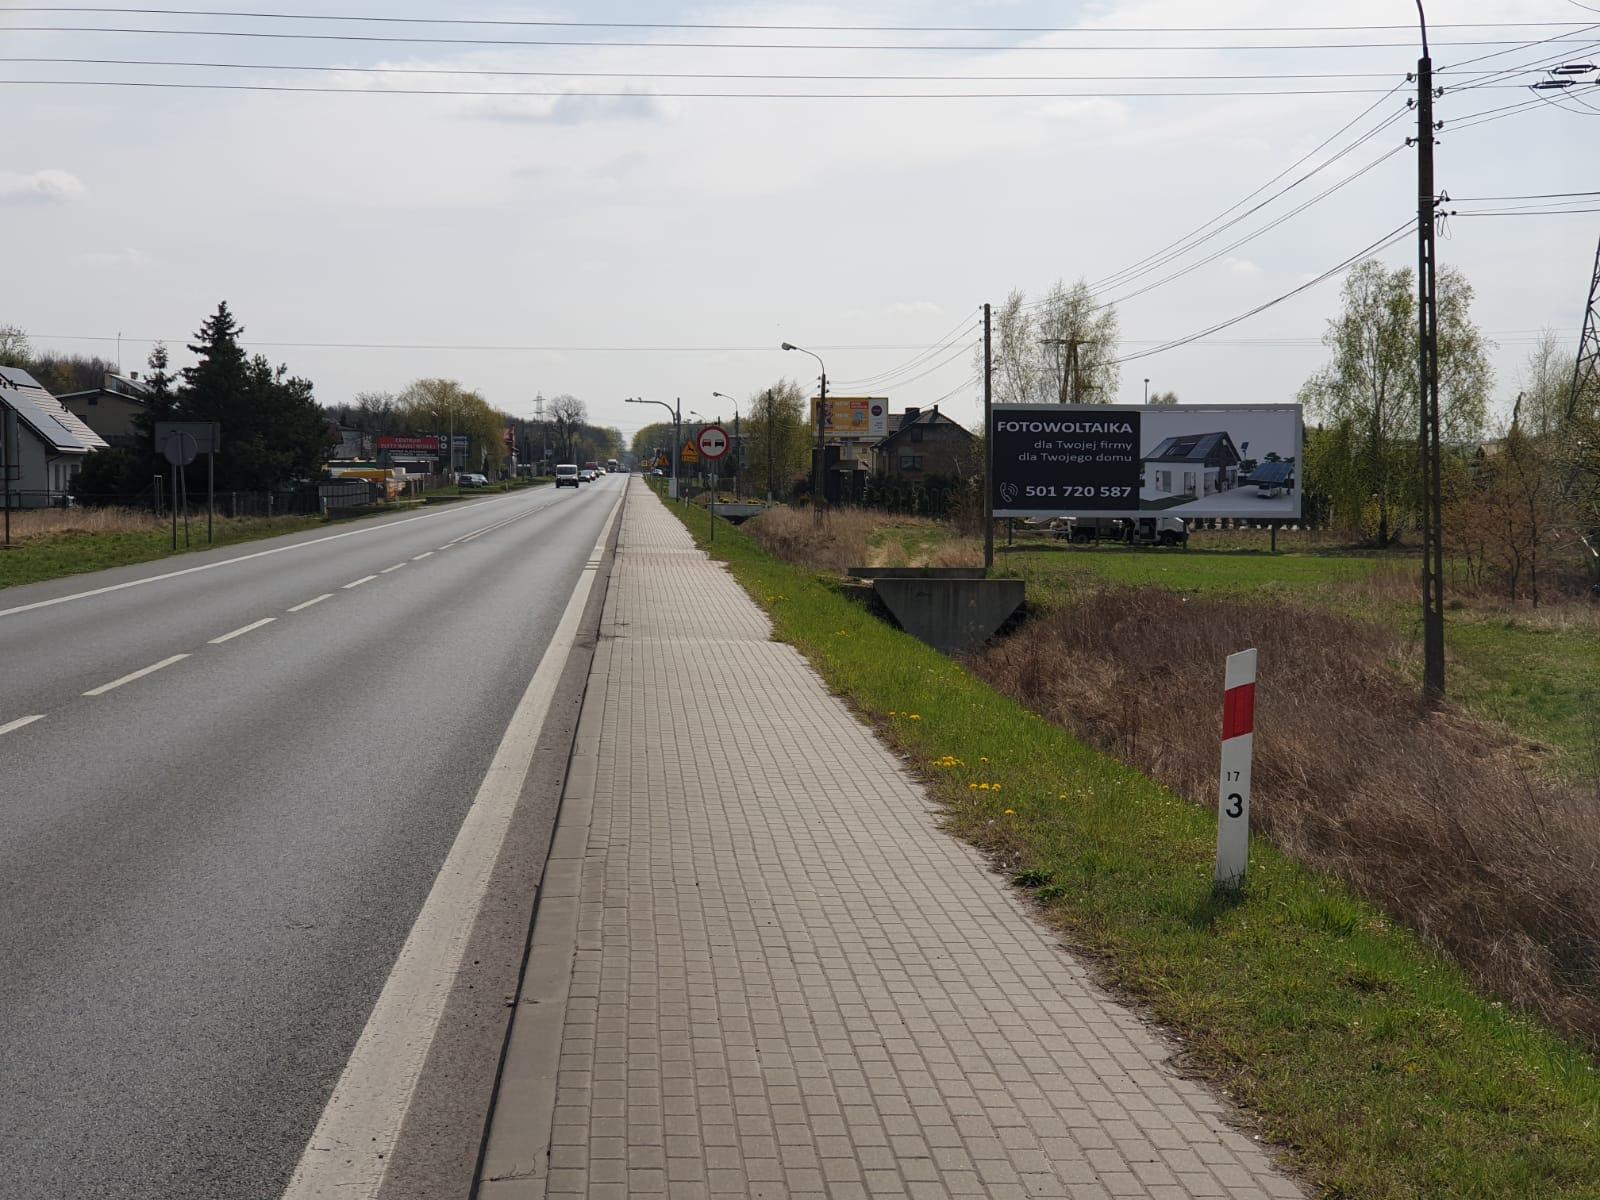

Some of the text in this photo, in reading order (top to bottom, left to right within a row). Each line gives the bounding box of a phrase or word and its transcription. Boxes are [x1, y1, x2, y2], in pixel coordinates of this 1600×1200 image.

[997, 421, 1133, 433] FOTOWOLTAIKA
[1034, 440, 1133, 451] dla Twojej firmy
[1018, 452, 1132, 463] dla Twojego domu
[1025, 486, 1131, 497] 501 720 587
[1226, 771, 1240, 782] 17
[1225, 792, 1243, 818] 3
